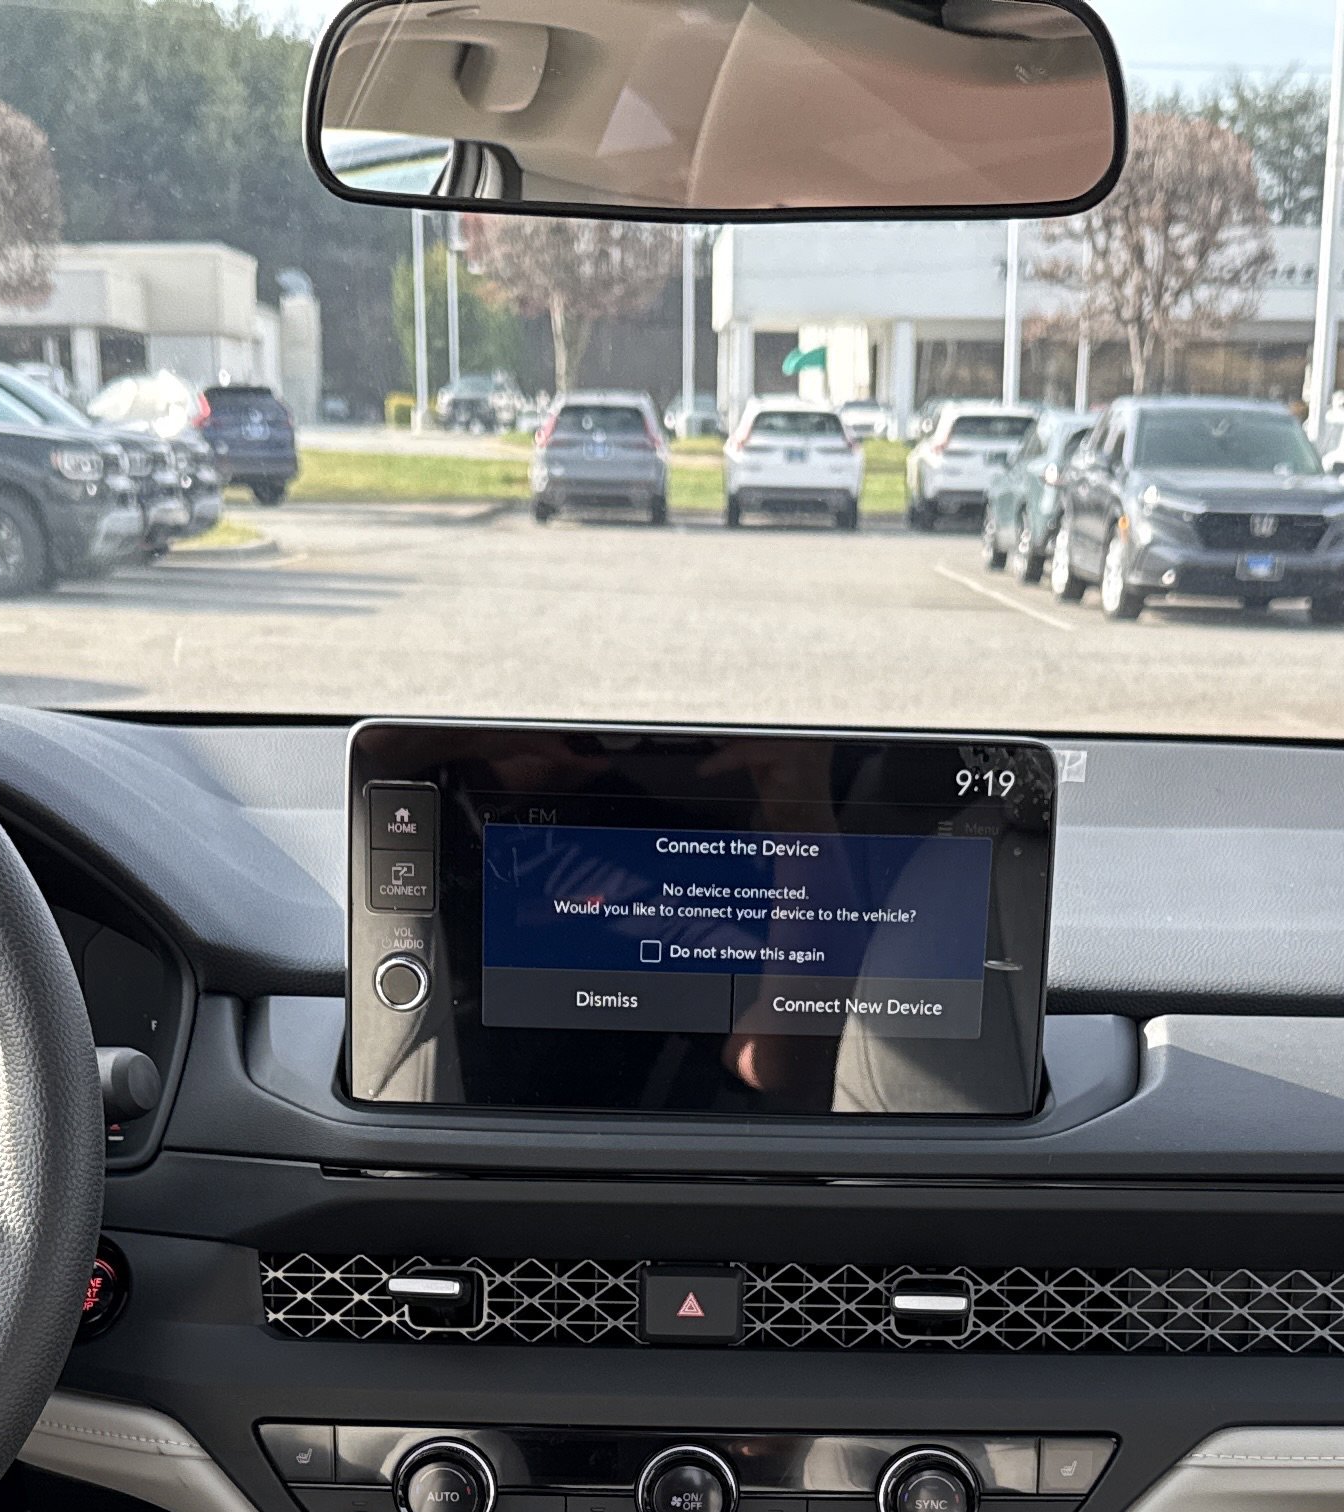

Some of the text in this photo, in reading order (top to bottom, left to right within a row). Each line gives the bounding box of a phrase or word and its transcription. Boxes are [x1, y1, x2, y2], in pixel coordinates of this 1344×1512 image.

[956, 769, 1015, 797] 9:19
[387, 822, 417, 834] HOME
[656, 837, 820, 857] Connect the Device
[379, 885, 427, 896] CONNECT
[662, 882, 810, 900] No device connected.
[554, 900, 917, 923] Would you like to connect your device to the vehicle?
[394, 927, 414, 938] VOL
[393, 939, 424, 950] AUDIO
[669, 945, 825, 964] Do not show this again
[576, 991, 638, 1008] Dismiss
[773, 996, 944, 1016] Connect New Device
[151, 1019, 158, 1032] F
[426, 1491, 460, 1502] AUTO
[682, 1492, 704, 1502] ON/
[682, 1501, 703, 1511] OFF
[914, 1498, 948, 1511] SYNC
